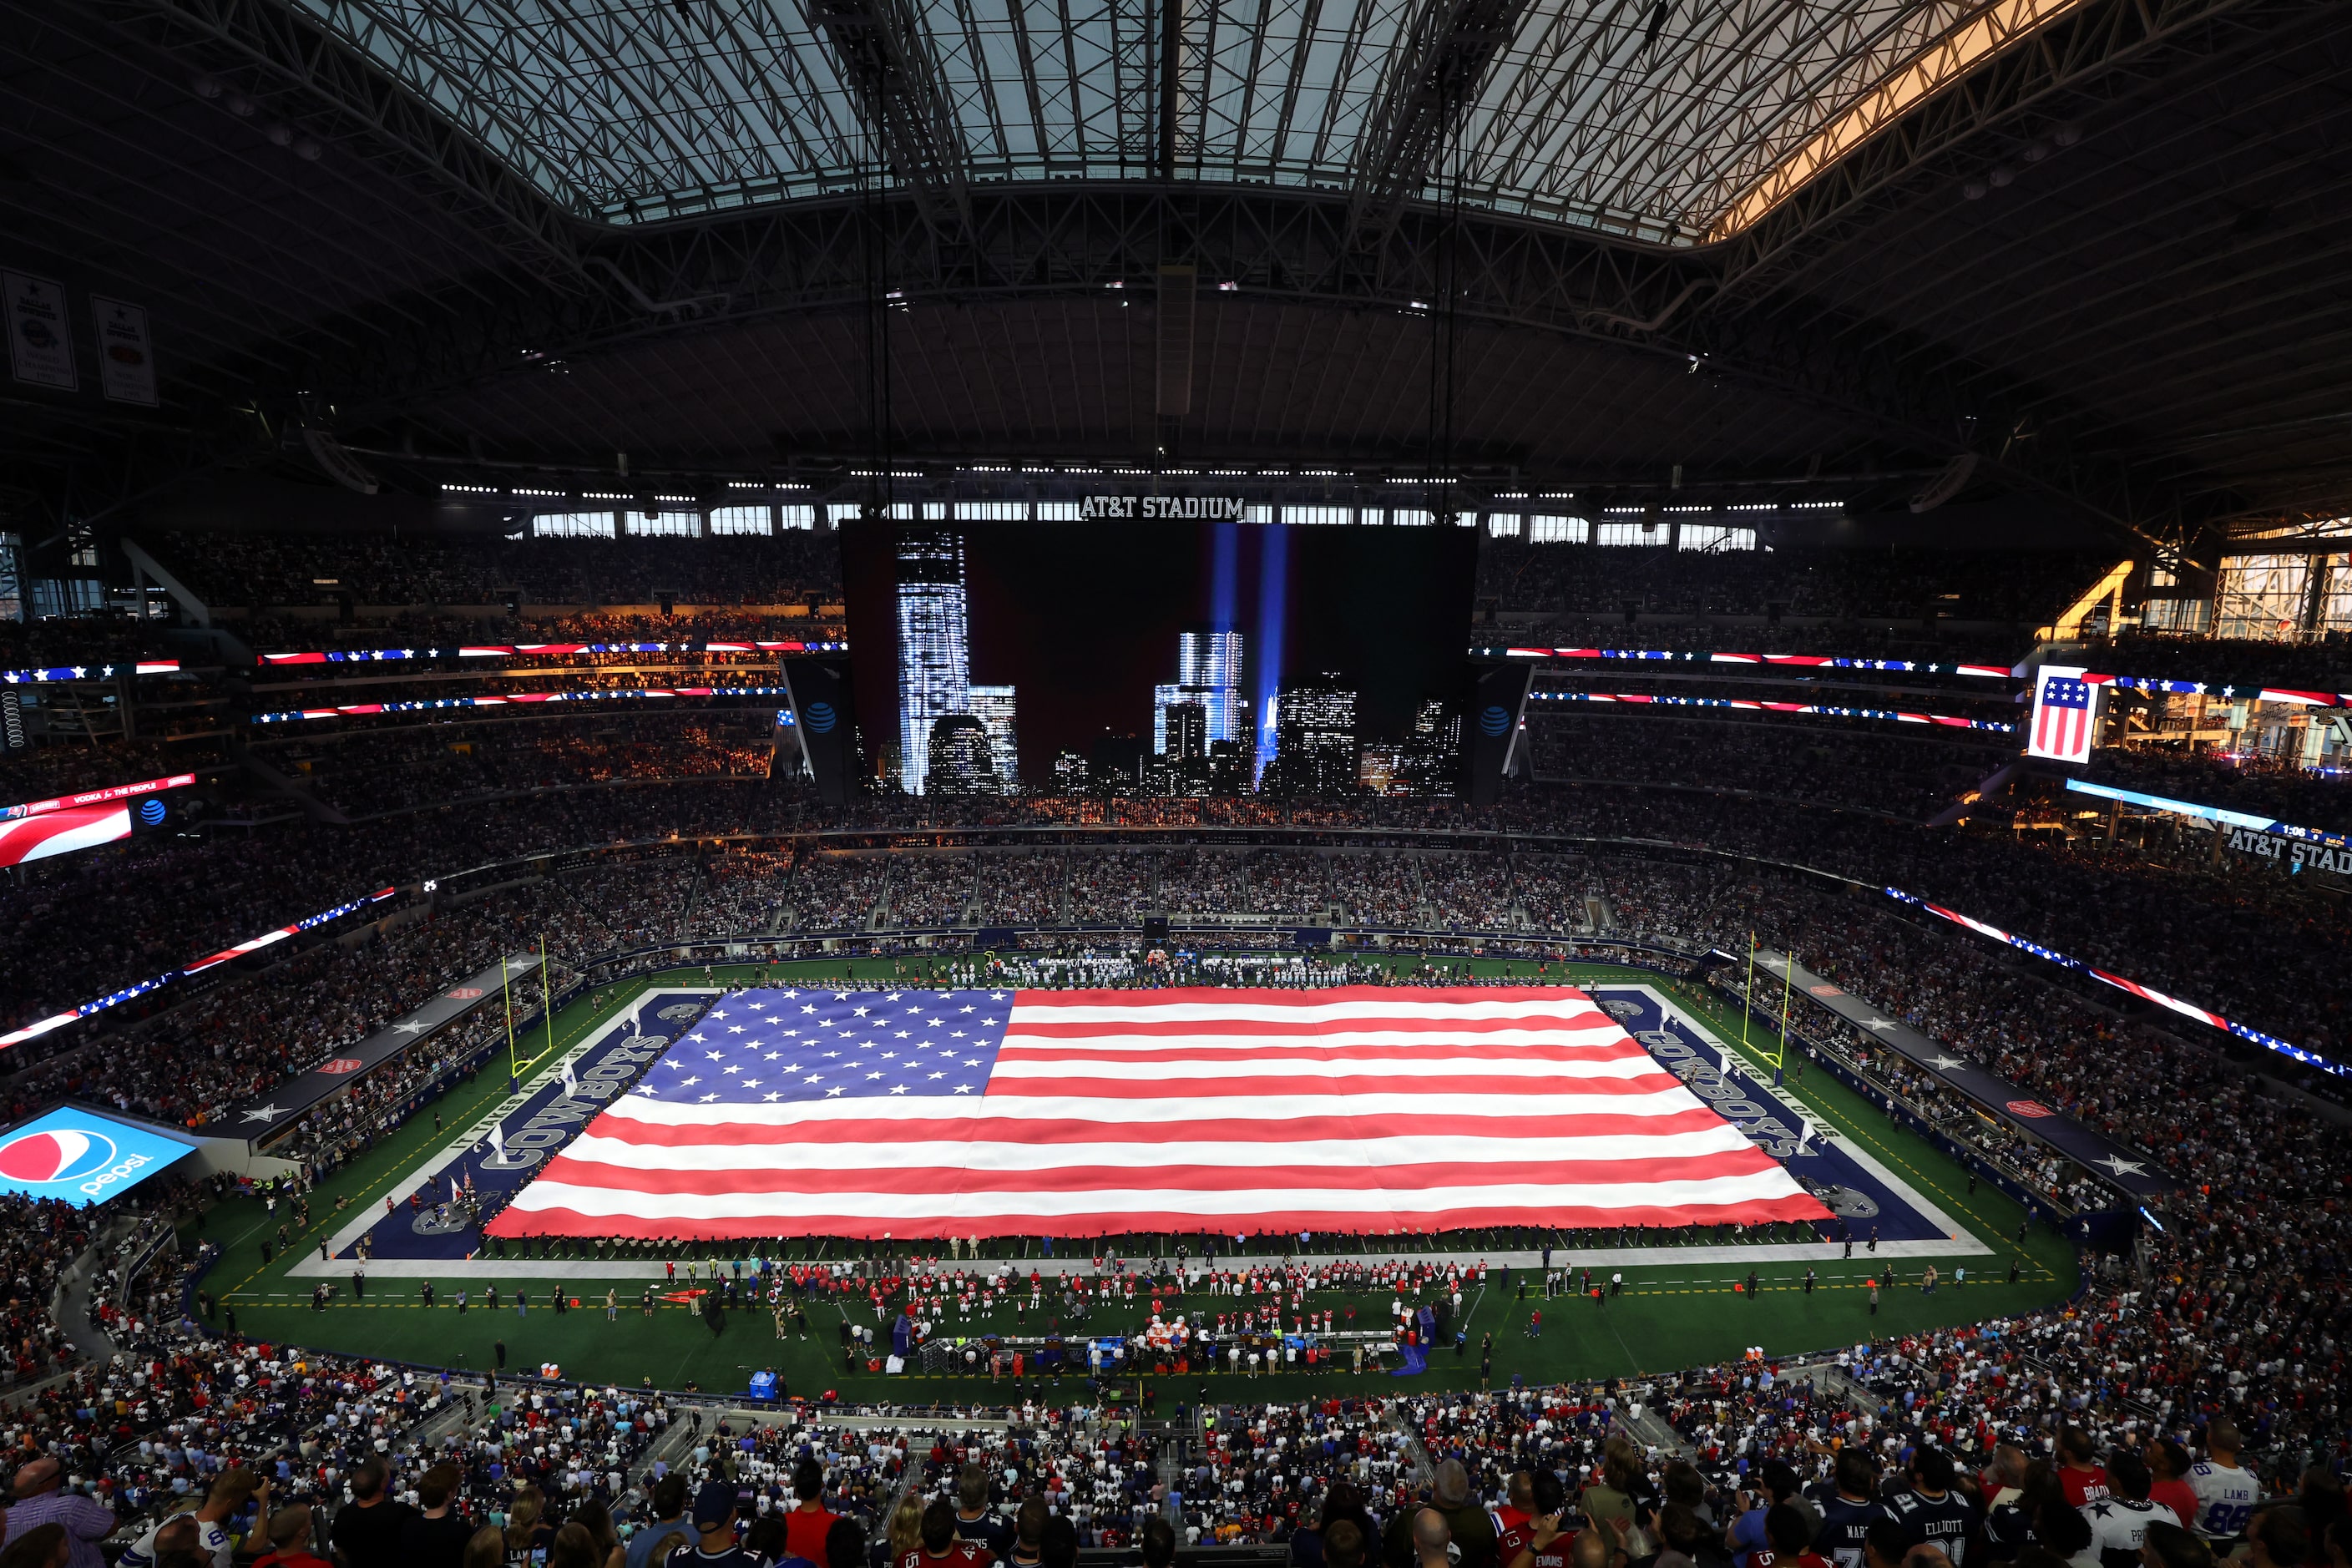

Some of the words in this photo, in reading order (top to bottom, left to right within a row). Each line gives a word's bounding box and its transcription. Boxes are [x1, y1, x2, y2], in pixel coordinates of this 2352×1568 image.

[17, 305, 57, 321] COWBOYS
[1080, 496, 1136, 517] AT&T
[1143, 497, 1244, 518] STADIUM
[74, 793, 102, 803] VODKA
[114, 787, 129, 796] THE
[129, 782, 156, 793] PEOPLE
[2283, 825, 2306, 837] 1:06
[2228, 829, 2287, 859] AT&T
[450, 1136, 468, 1149] IT
[471, 1099, 525, 1135] TAKES
[523, 1076, 549, 1095] ALL
[569, 1047, 588, 1059] US
[1633, 1030, 1819, 1156] COWBOYS
[1708, 1041, 1725, 1050] IT
[1723, 1052, 1768, 1080] TAKES
[1764, 1084, 1792, 1101] ALL
[1791, 1105, 1816, 1119] OF
[1812, 1122, 1840, 1139] US
[480, 1035, 669, 1170] COWBOYS
[79, 1153, 152, 1196] pepsi
[2223, 1489, 2248, 1501] LAMB
[1925, 1519, 1963, 1535] ELLIOTT
[2203, 1503, 2253, 1535] 88
[1505, 1530, 1520, 1548] 13
[1846, 1525, 1869, 1539] MAR
[1535, 1555, 1563, 1568] EVANS
[1834, 1547, 1866, 1568] 7
